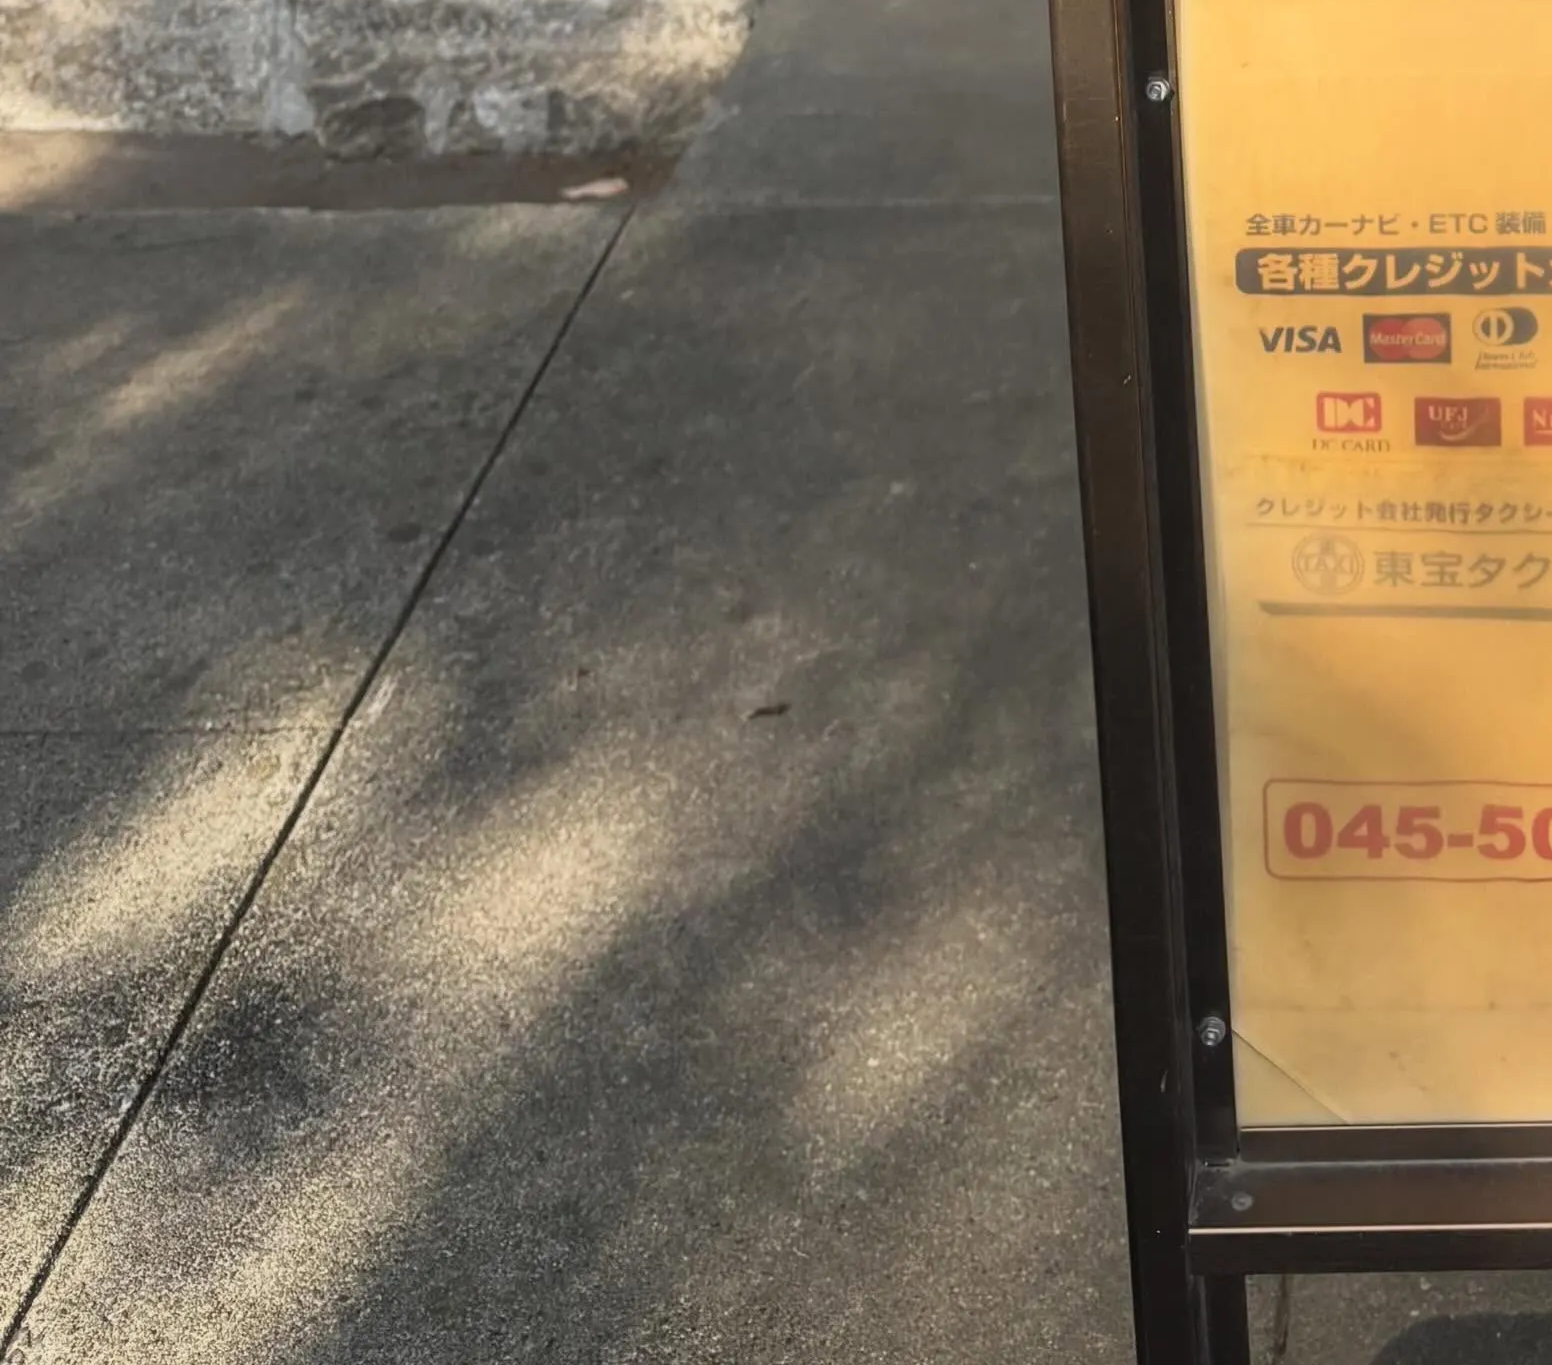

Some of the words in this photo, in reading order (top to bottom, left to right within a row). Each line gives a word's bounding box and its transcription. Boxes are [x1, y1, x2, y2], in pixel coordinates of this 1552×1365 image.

[1259, 325, 1342, 353] VISA
[1370, 331, 1446, 346] MasterCard
[1428, 405, 1468, 424] UFJ
